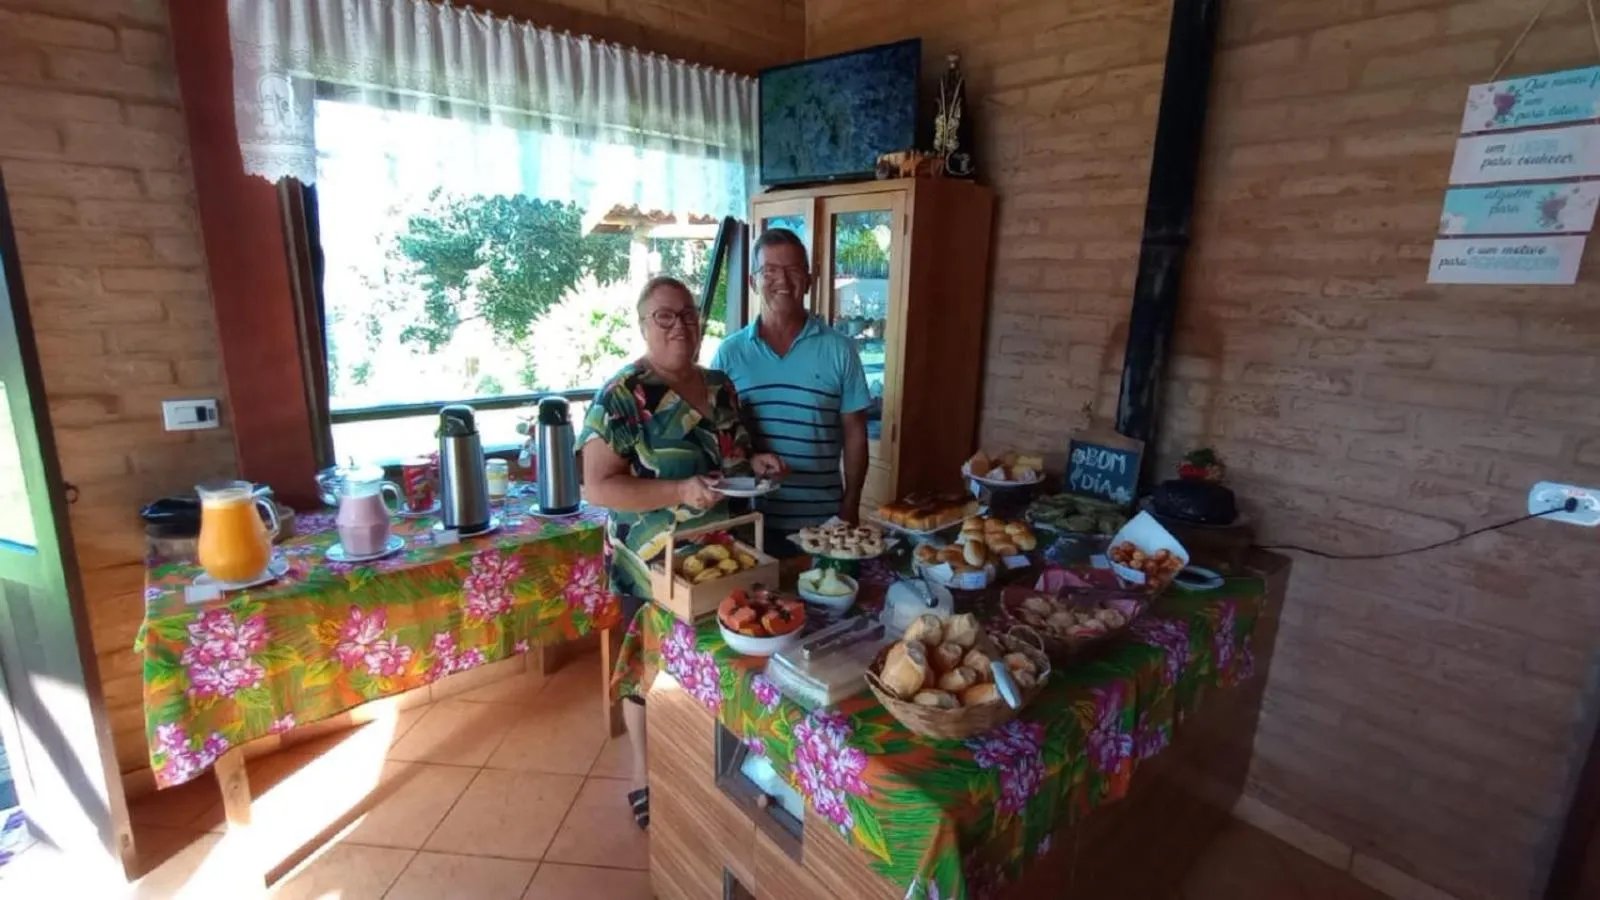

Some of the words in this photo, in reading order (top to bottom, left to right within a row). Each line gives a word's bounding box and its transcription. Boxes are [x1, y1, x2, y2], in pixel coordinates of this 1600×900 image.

[1485, 144, 1506, 154] um
[1480, 156, 1512, 172] para
[1517, 154, 1574, 166] conhecer
[1488, 204, 1520, 218] para
[1477, 246, 1497, 255] um
[1501, 244, 1547, 256] motivo
[1438, 255, 1467, 270] para
[1086, 446, 1126, 475] BOM
